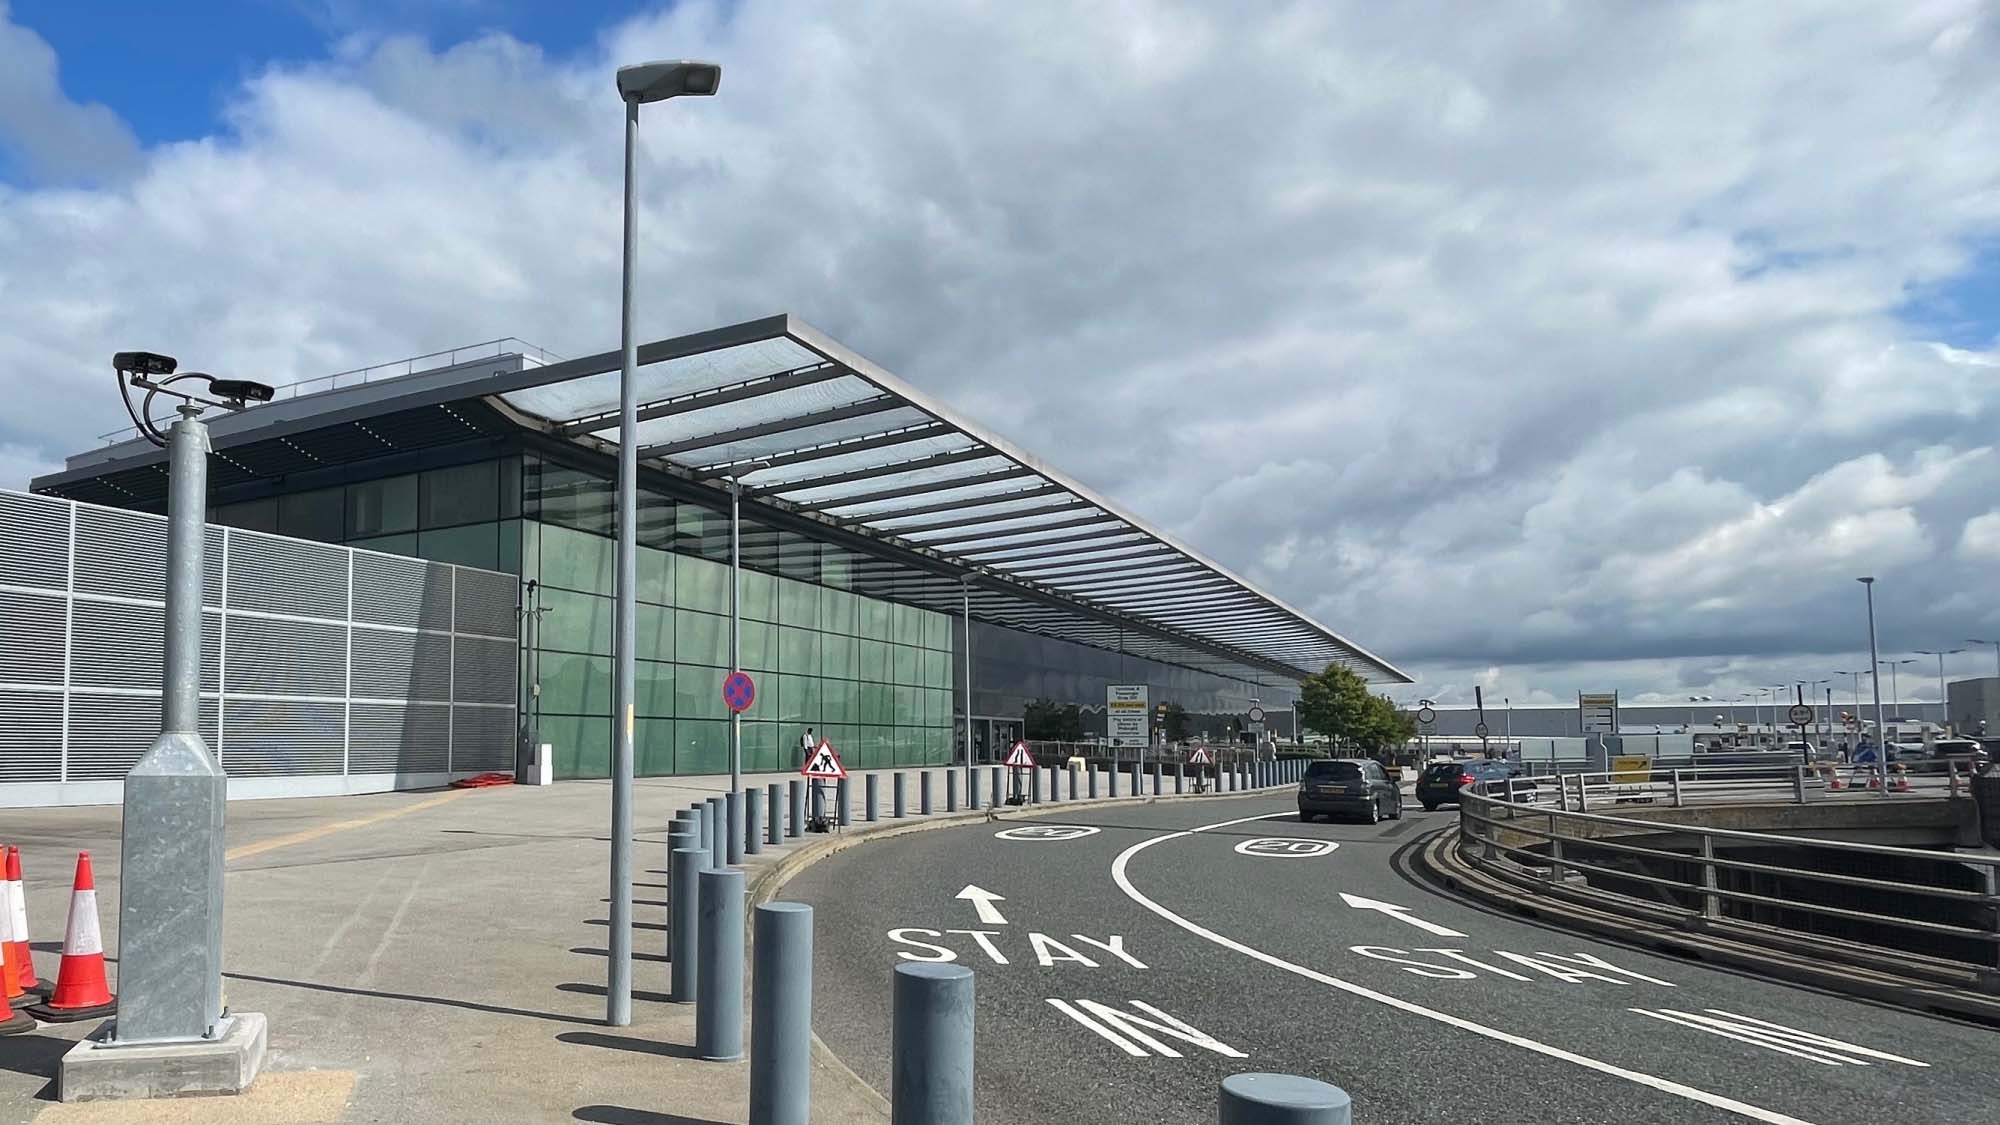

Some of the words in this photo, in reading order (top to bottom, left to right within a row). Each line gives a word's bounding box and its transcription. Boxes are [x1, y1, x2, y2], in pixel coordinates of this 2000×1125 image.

[1247, 840, 1325, 853] 20
[887, 928, 1150, 969] STAY
[1348, 945, 1677, 987] STAY
[1046, 998, 1250, 1059] IN
[1627, 1007, 1931, 1067] IN
